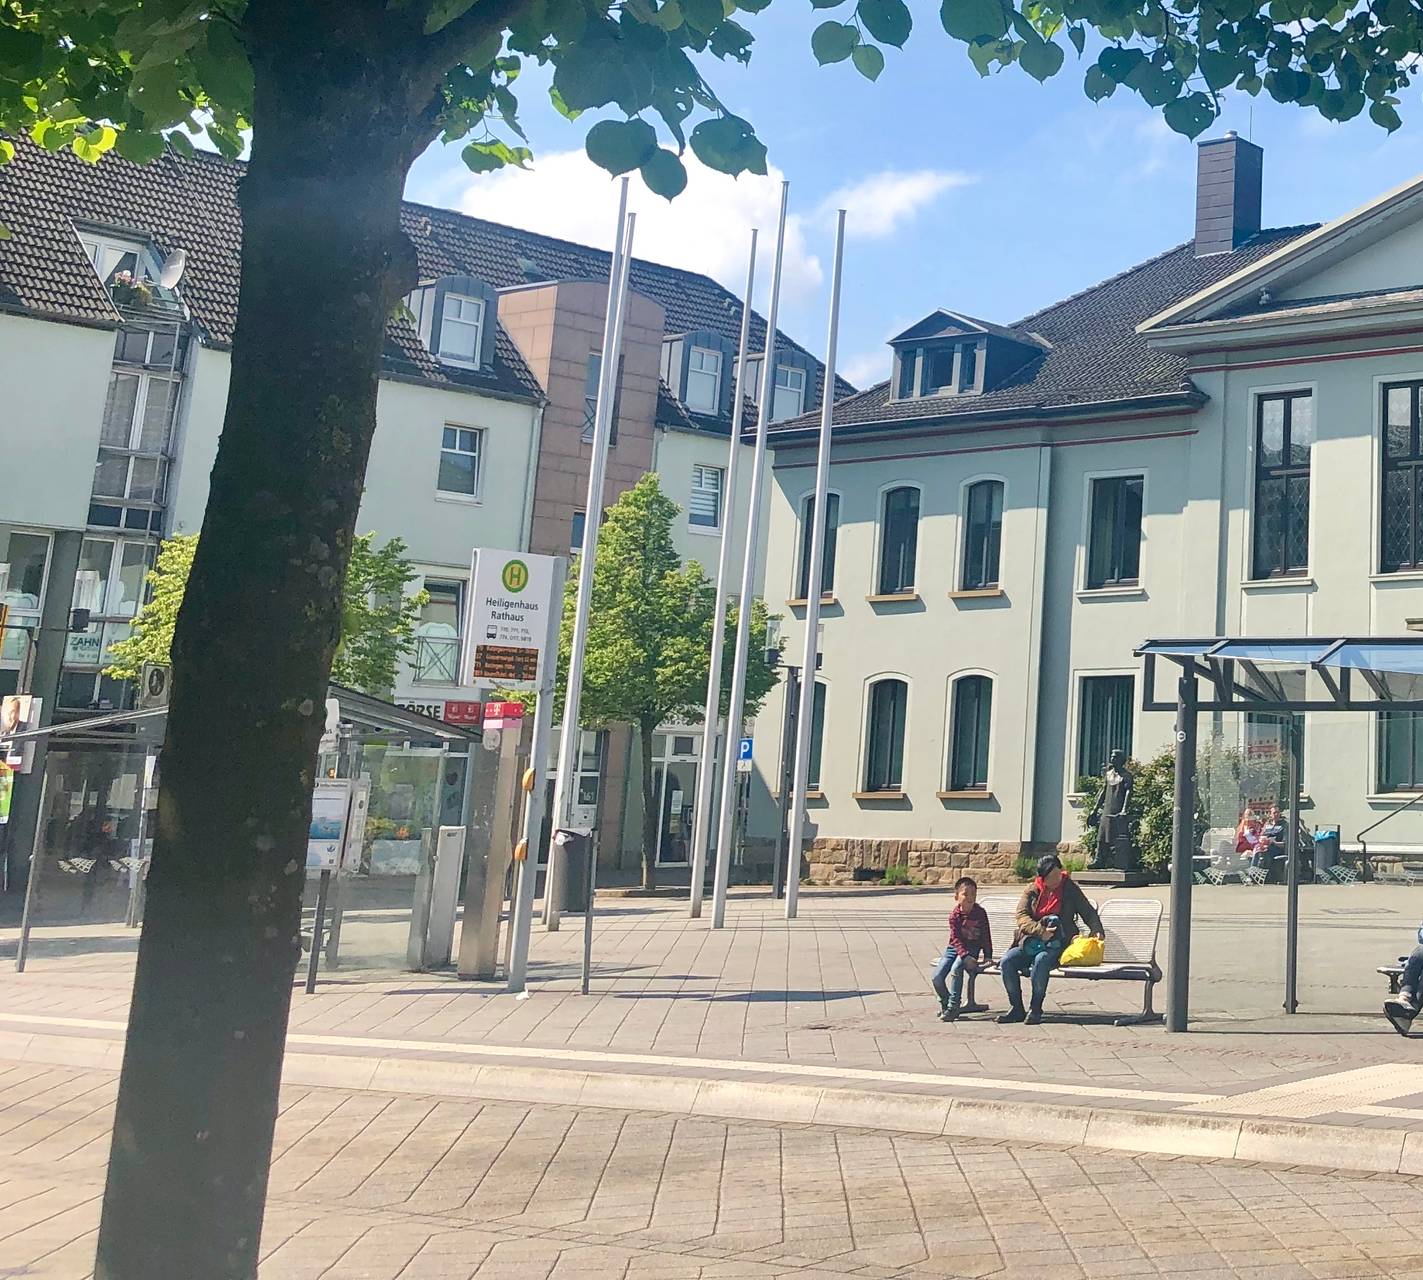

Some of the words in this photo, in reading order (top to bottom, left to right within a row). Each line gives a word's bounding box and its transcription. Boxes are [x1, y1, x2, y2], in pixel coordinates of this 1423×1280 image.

[485, 597, 539, 611] Heiligenhaus
[490, 610, 524, 622] Rathaus
[70, 637, 99, 647] ZAHN
[741, 741, 750, 759] P
